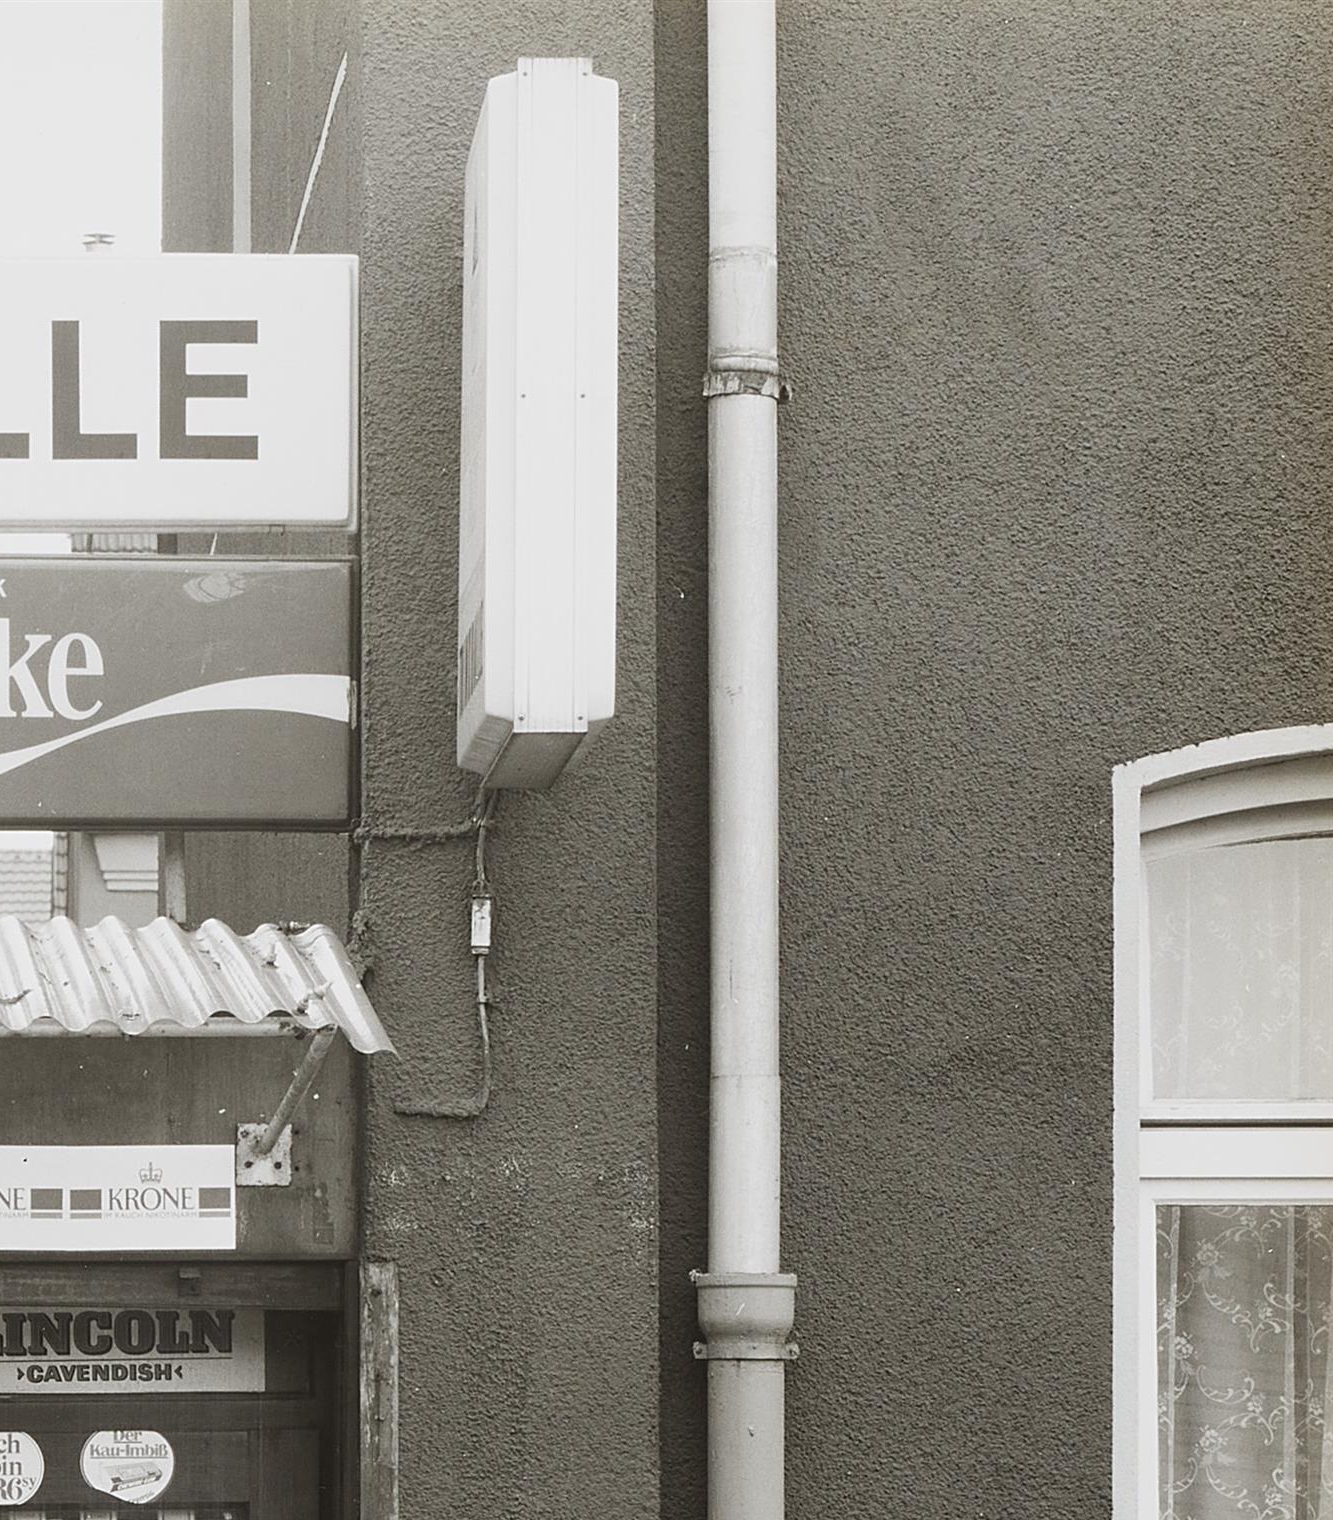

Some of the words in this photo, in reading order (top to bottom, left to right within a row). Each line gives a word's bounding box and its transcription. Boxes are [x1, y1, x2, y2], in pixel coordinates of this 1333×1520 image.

[109, 1187, 194, 1211] KRONE
[113, 1430, 142, 1442] Der
[89, 1443, 169, 1457] Kau-Imbiß
